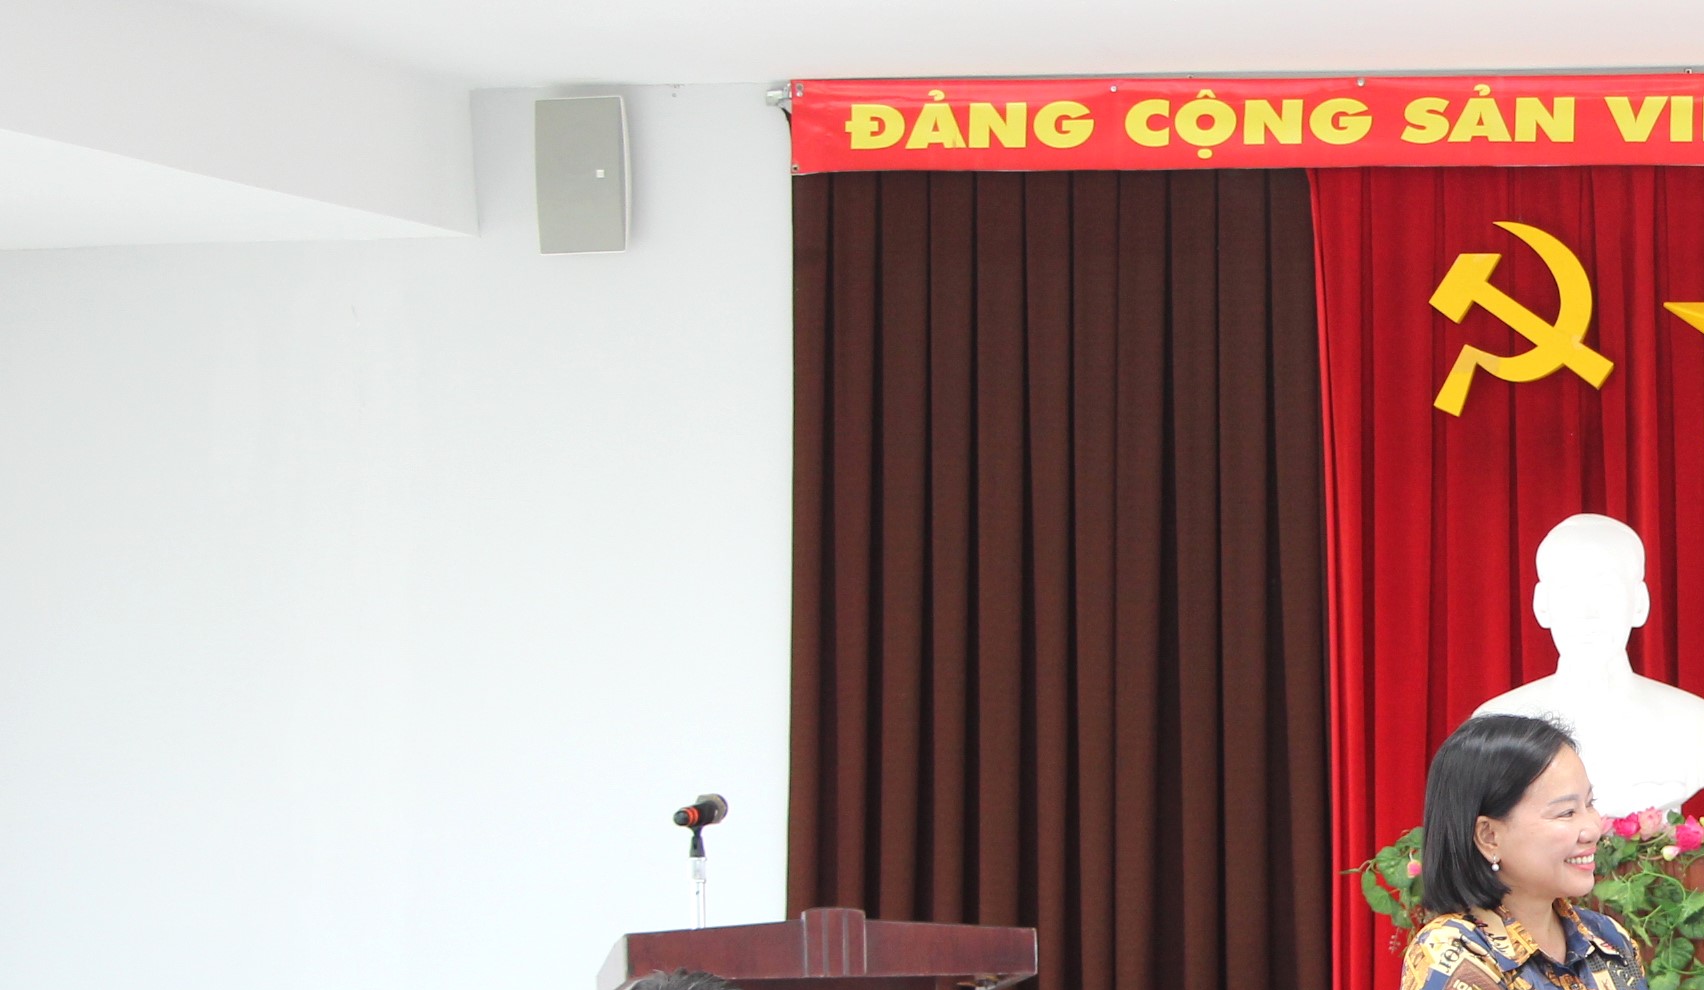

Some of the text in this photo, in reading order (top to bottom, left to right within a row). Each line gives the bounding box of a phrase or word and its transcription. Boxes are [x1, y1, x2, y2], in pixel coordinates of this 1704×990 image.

[844, 88, 1095, 150] ĐẢNG
[1124, 88, 1373, 160] CỘNG
[1400, 83, 1576, 145] SẢN
